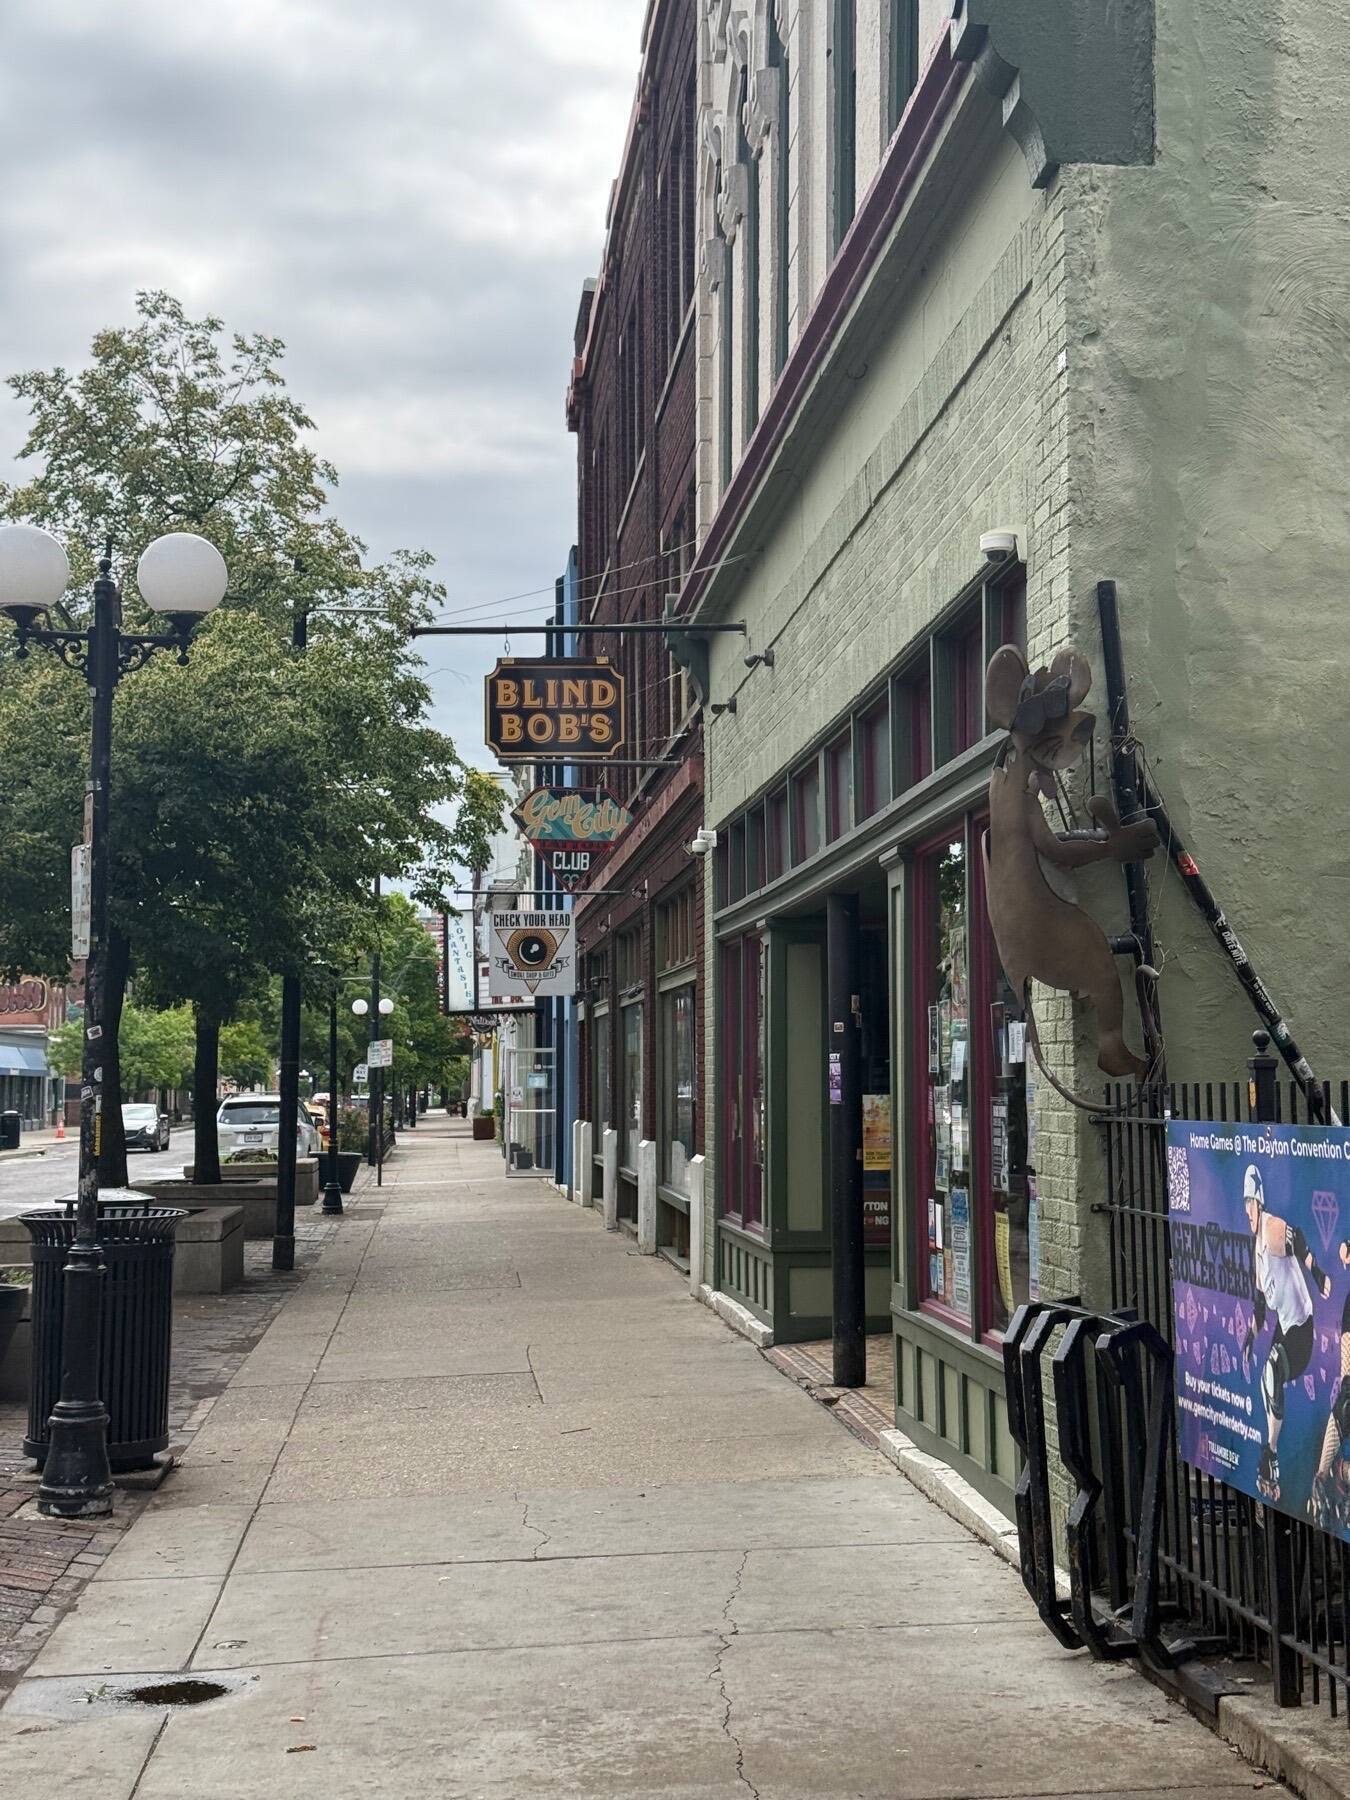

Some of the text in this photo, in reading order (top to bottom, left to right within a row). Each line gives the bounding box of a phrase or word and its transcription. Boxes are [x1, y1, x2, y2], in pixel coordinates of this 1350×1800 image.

[495, 679, 616, 709] BLIND
[501, 713, 612, 743] BOB'S
[516, 789, 630, 841] Gem City
[553, 851, 590, 870] CLUB
[494, 913, 571, 927] CHECK YOUR HEAD
[1189, 1132, 1209, 1150] Home
[1210, 1133, 1233, 1150] Games
[1234, 1135, 1242, 1156] @
[1242, 1135, 1257, 1153] The
[1258, 1136, 1290, 1158] Dayton
[1290, 1138, 1342, 1159] Convention
[1172, 1222, 1207, 1262] GEM
[1173, 1255, 1217, 1289] ROLLER
[1185, 1371, 1253, 1416] Buy your tickets now @
[1178, 1395, 1262, 1444] www.gemcityrollerderby.com
